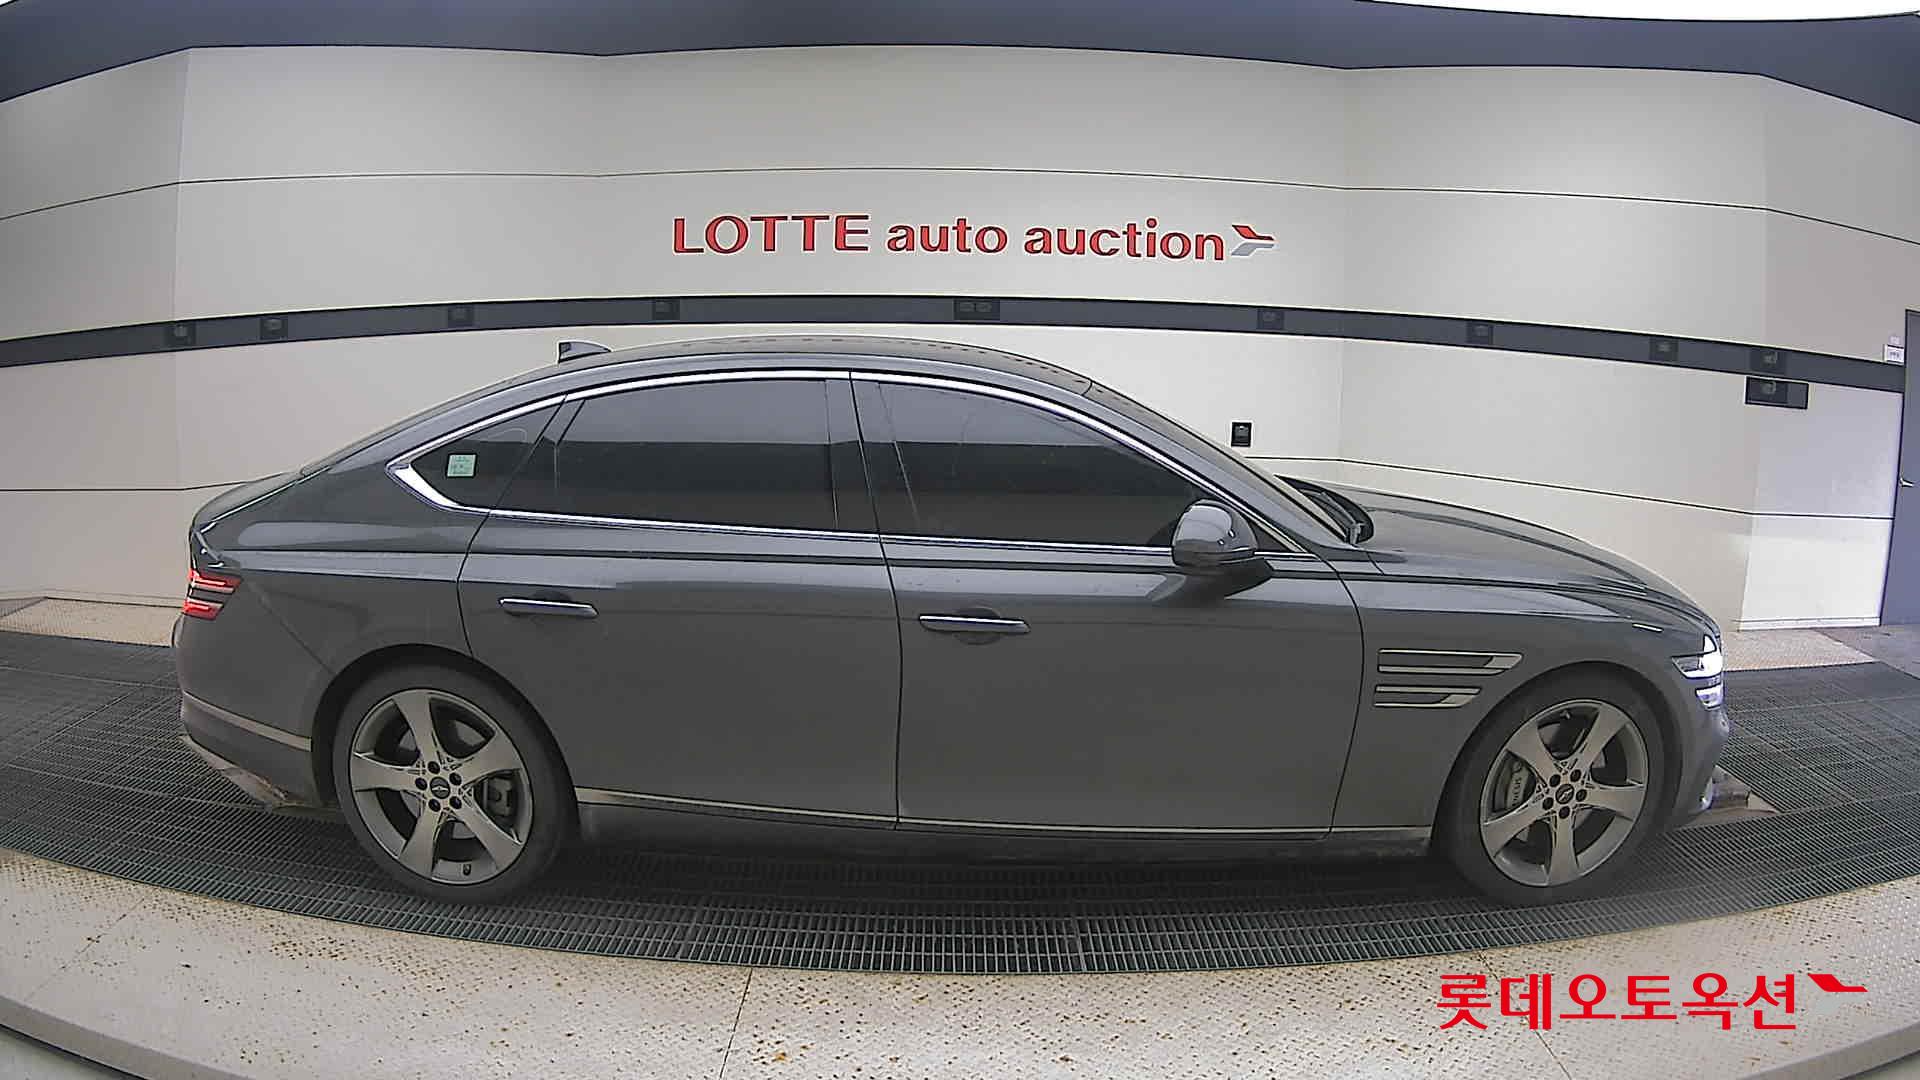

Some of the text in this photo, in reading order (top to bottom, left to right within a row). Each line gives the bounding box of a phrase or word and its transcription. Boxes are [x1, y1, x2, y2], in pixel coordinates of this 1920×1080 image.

[673, 214, 1226, 260] LOTTE auto auction
